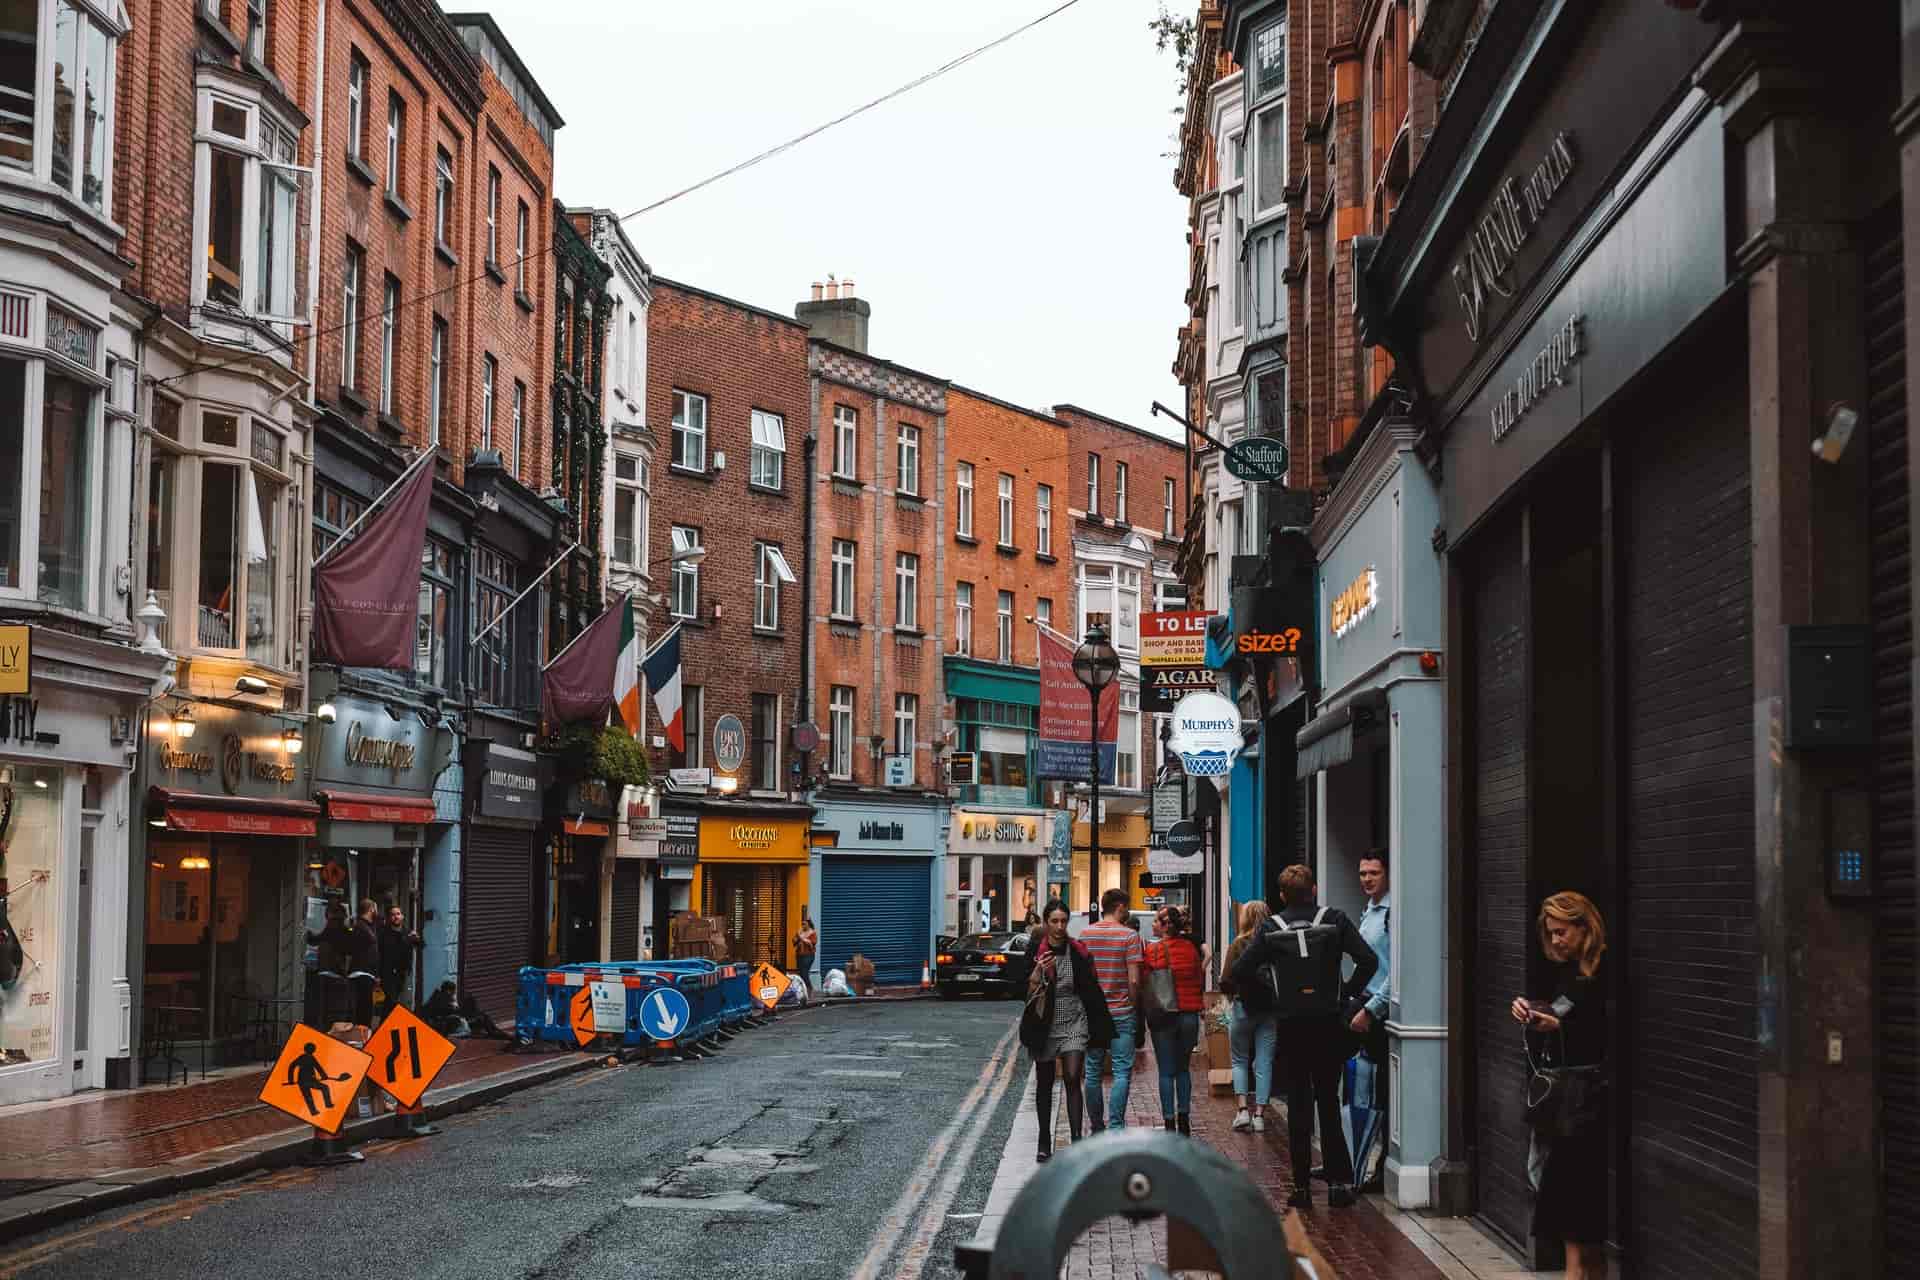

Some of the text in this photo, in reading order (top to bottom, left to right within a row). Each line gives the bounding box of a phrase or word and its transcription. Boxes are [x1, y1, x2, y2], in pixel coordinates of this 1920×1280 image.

[1522, 130, 1577, 223] DUBLIN
[1490, 313, 1578, 446] NAIL BOUTIQUE
[1246, 445, 1282, 463] Stafford
[1155, 617, 1207, 632] TO LE
[1143, 639, 1165, 648] SHOP
[1238, 628, 1302, 653] size?
[1153, 670, 1217, 685] AGAR
[1181, 717, 1234, 730] MURPHY'S
[490, 769, 507, 787] LOUIS
[995, 822, 1025, 842] SHING
